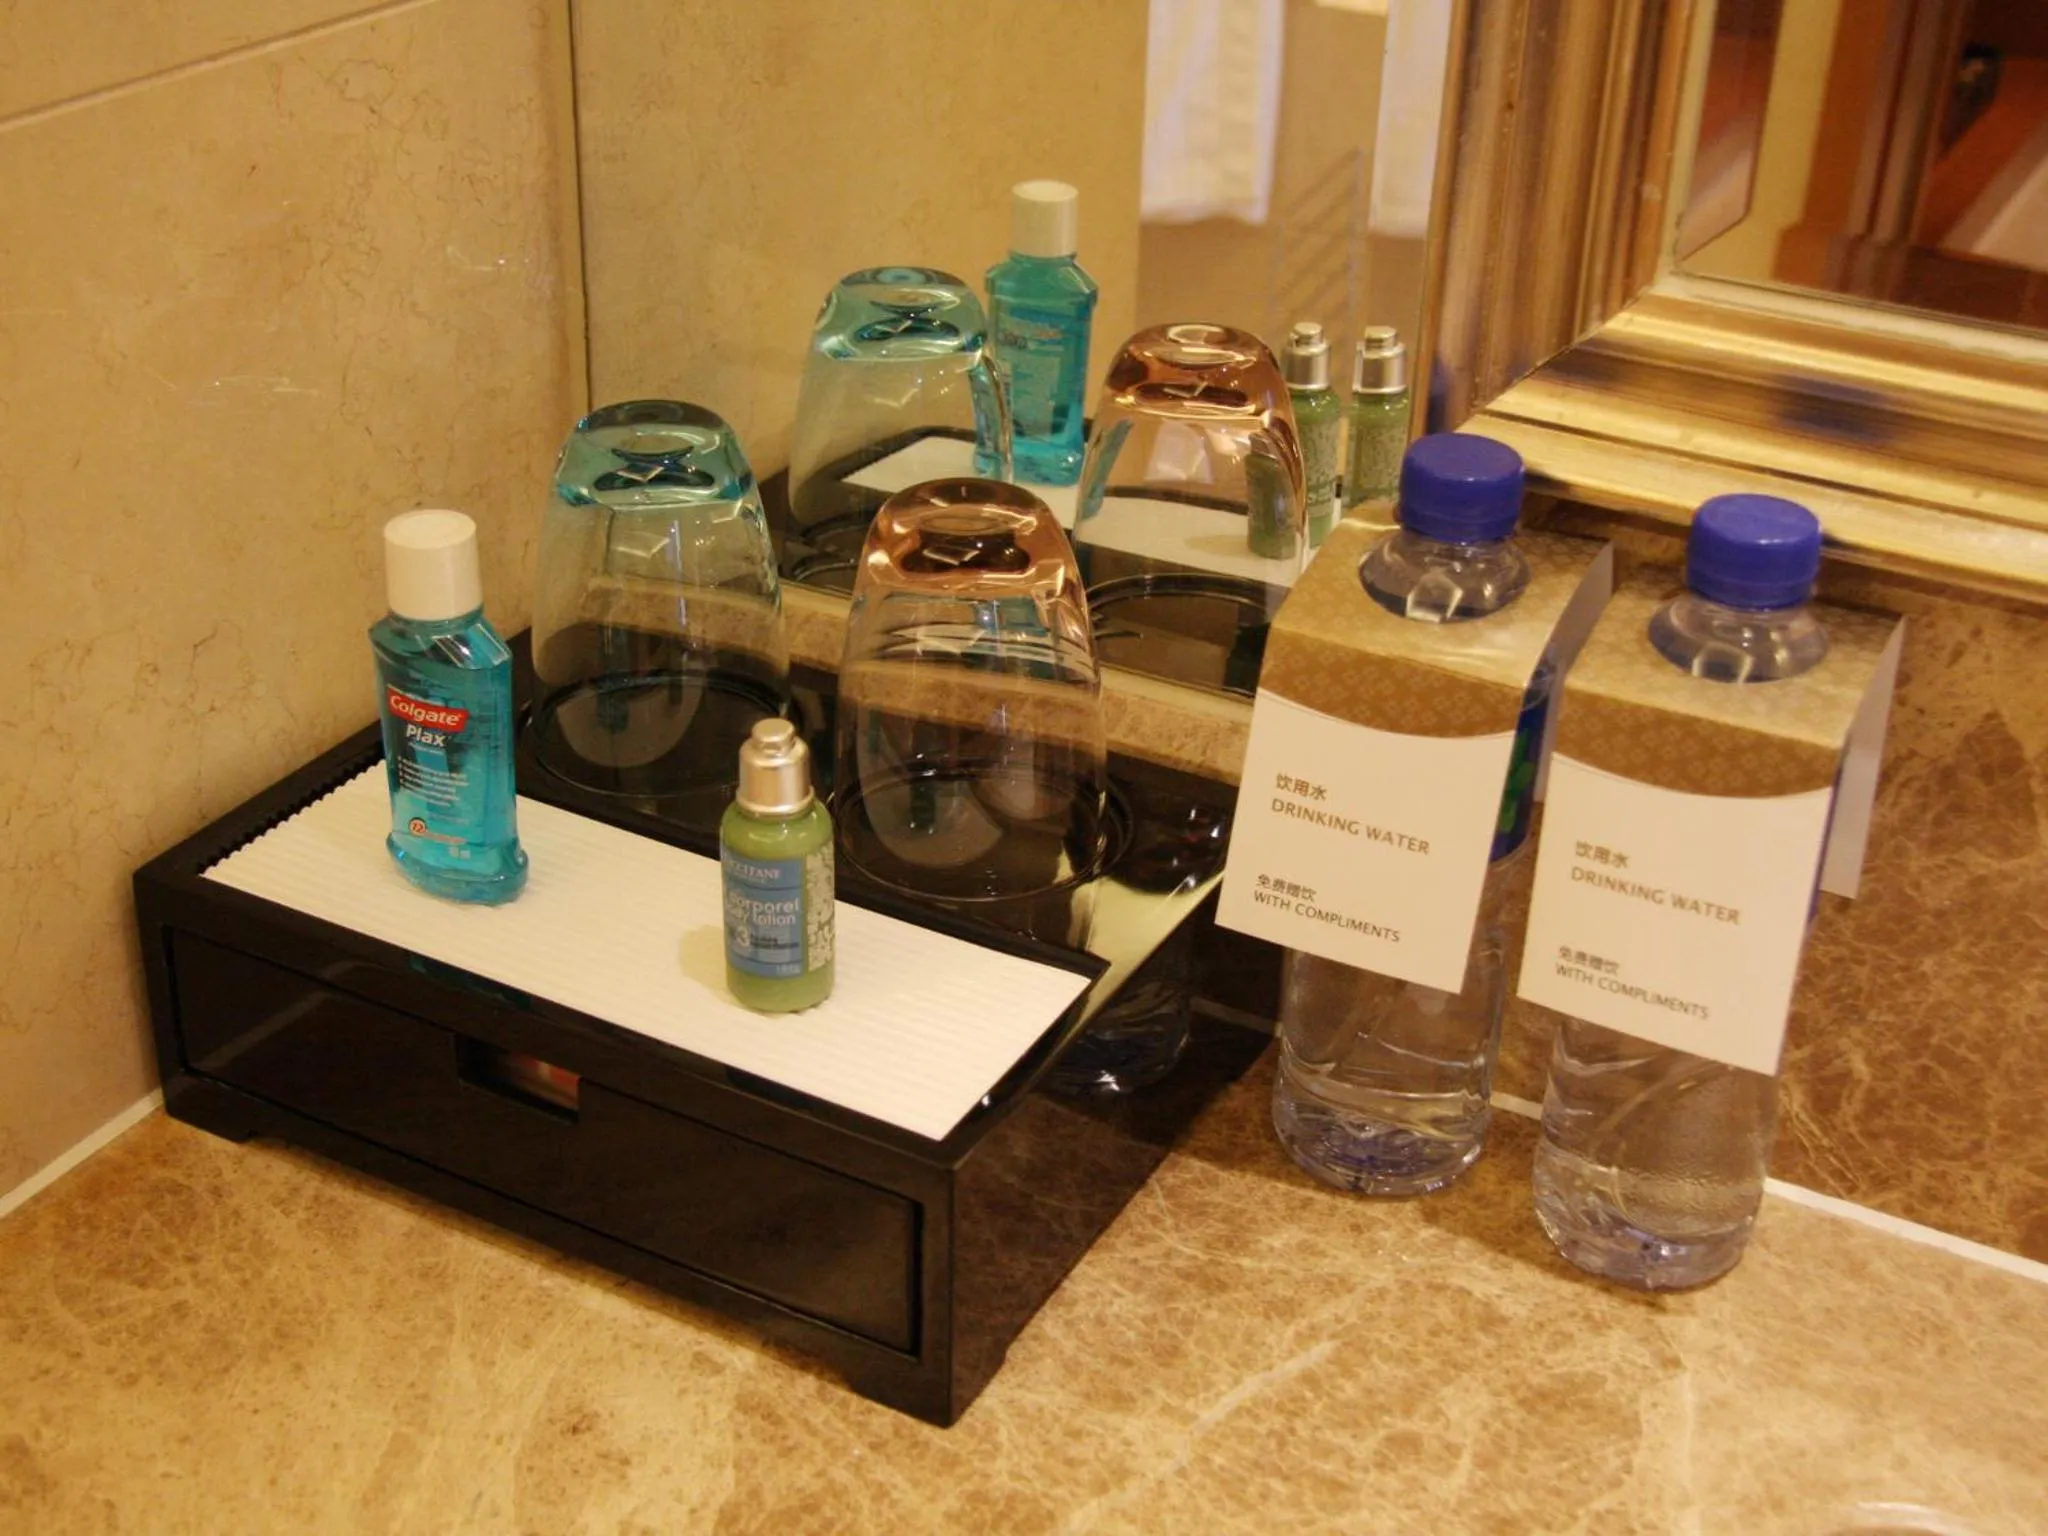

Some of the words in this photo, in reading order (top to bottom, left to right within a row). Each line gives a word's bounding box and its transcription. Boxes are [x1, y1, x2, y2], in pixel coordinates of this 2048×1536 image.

[389, 695, 463, 727] Colgate
[406, 724, 445, 747] Plax
[1276, 773, 1327, 801] 饮用水
[1271, 797, 1360, 836] DRINKING
[1366, 825, 1430, 855] WATER
[1575, 841, 1629, 868] 饮用水
[1256, 873, 1317, 903] 免费赠饮
[1571, 866, 1665, 905] DRINKING
[1671, 894, 1740, 925] WATER
[1254, 890, 1291, 911] WITH
[1295, 903, 1401, 943] COMPLIMENTS
[1556, 964, 1594, 985] WITH
[1598, 977, 1709, 1019] COMPLIMENTS
